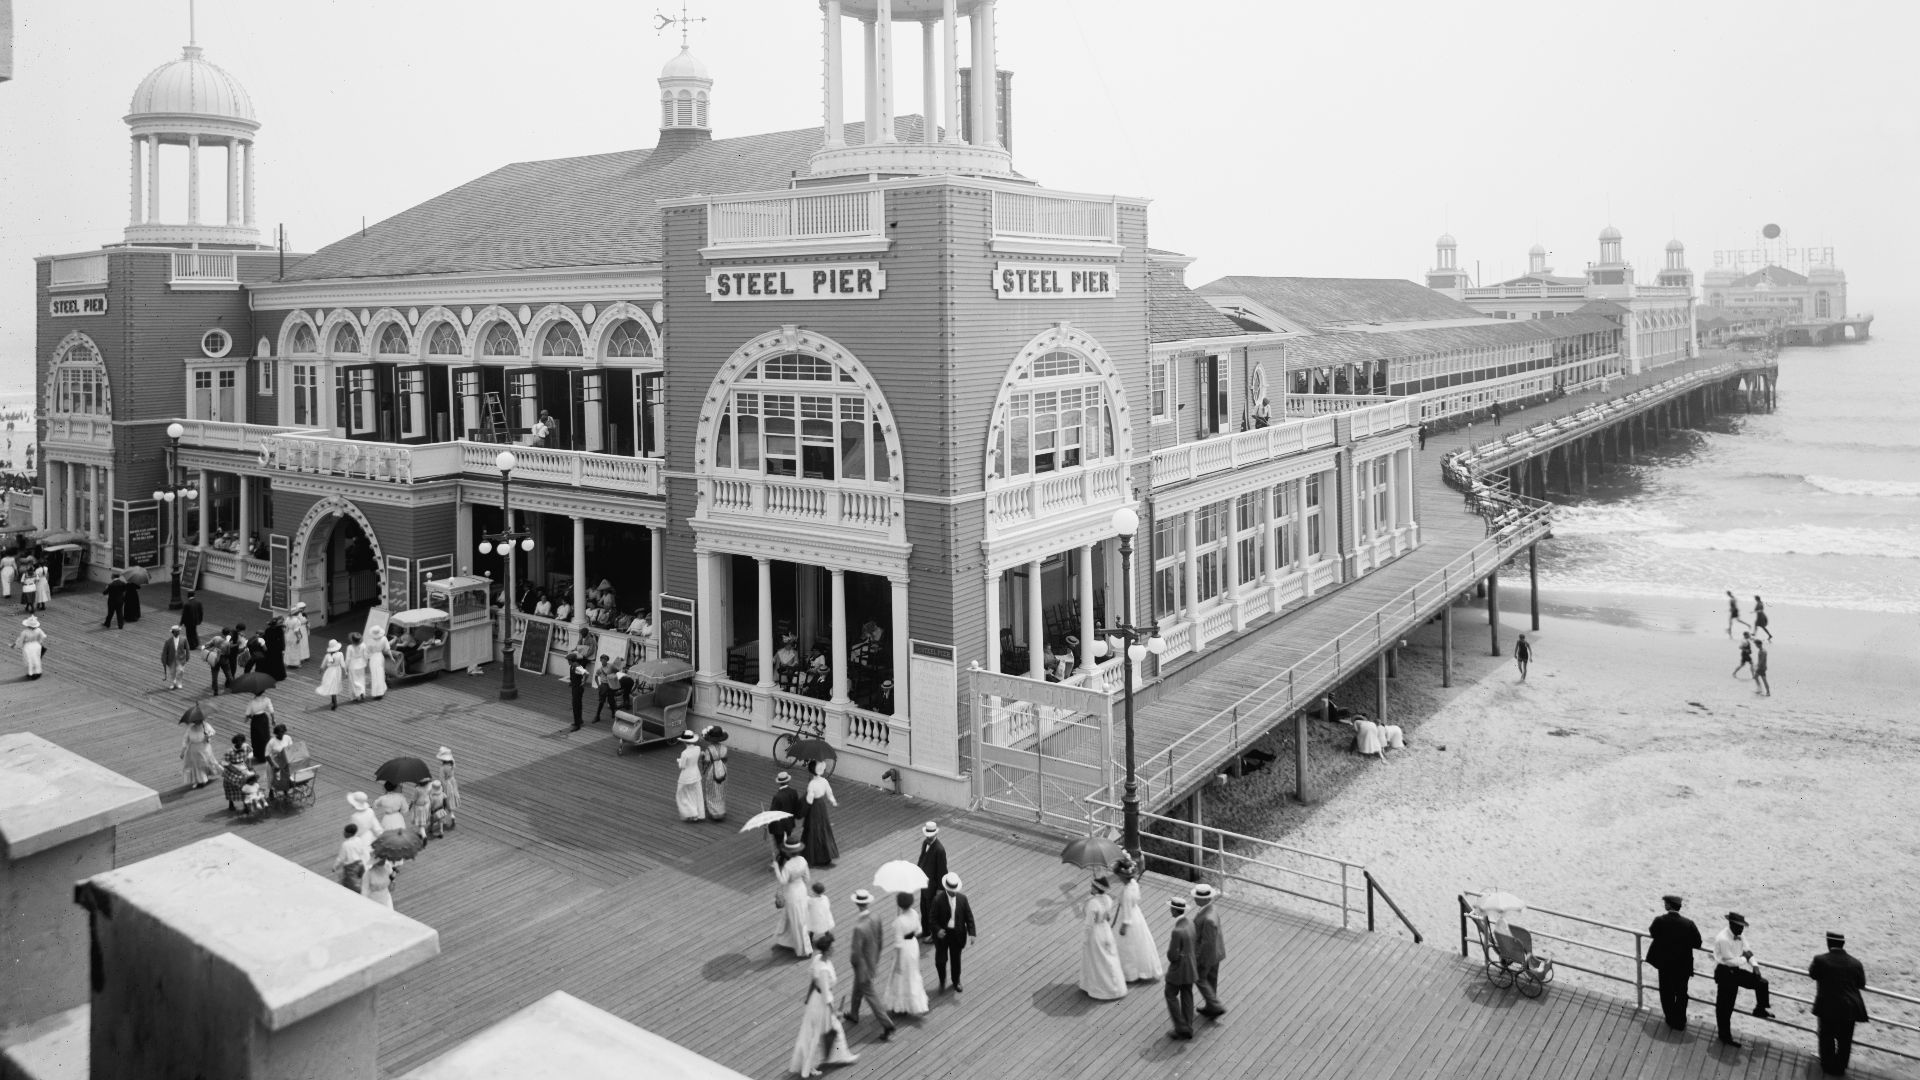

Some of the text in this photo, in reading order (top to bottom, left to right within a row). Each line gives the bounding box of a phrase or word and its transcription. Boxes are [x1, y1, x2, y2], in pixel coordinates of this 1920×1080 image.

[1713, 247, 1834, 265] STEEL PIER
[717, 269, 873, 296] STEEL PIER
[1002, 269, 1110, 293] STEEL PIER
[53, 298, 104, 314] STEEL PIER
[257, 436, 414, 485] STEEL PIER
